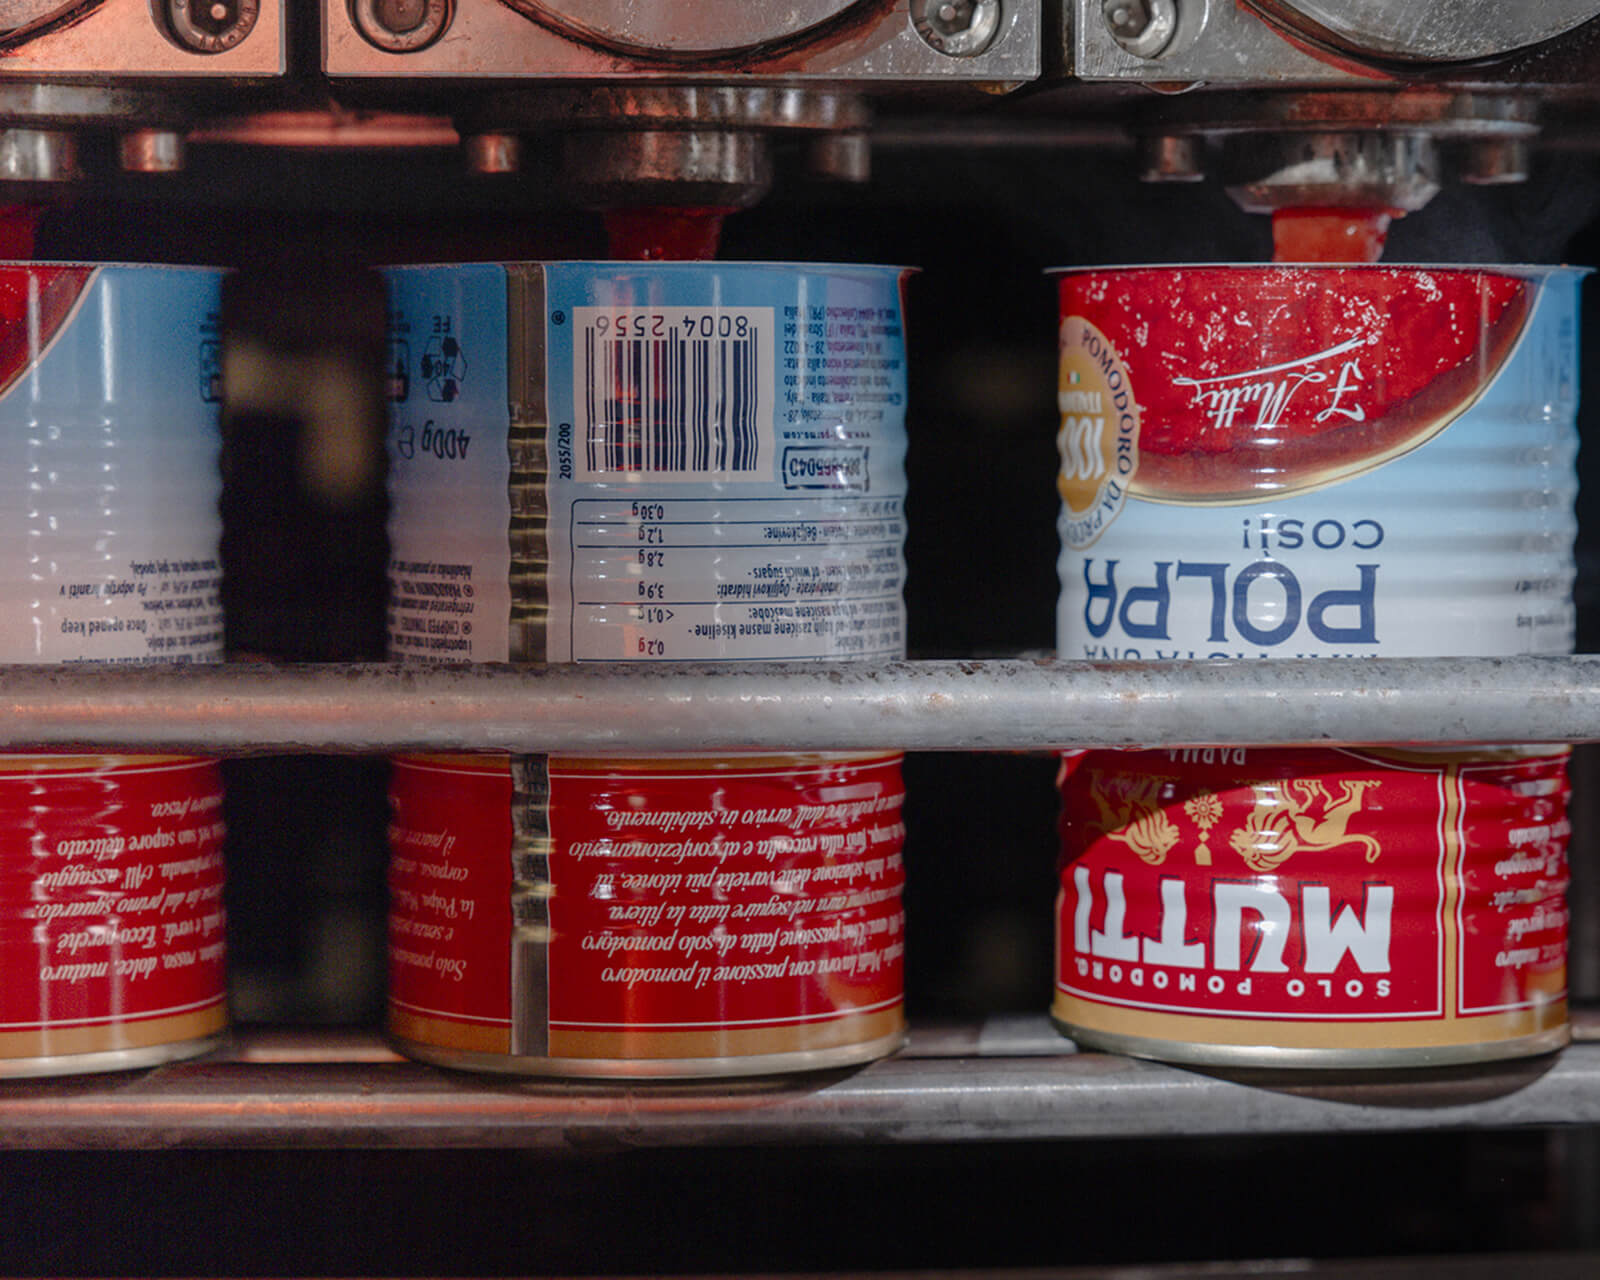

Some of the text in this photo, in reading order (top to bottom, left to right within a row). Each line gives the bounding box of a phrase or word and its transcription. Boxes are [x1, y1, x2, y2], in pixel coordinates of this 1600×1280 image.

[433, 316, 451, 333] FE
[595, 314, 748, 337] 8004 2556
[1081, 327, 1134, 475] POMODORO
[1187, 372, 1326, 431] Mutti
[421, 420, 470, 460] 400g
[558, 423, 571, 479] 2055/200
[1101, 480, 1121, 513] DA
[632, 502, 664, 520] 0,30 g
[638, 525, 664, 543] 1,2 g
[1242, 518, 1385, 557] COSÌ!
[638, 549, 664, 567] 2,8 g
[753, 564, 783, 579] sugars
[638, 581, 664, 598] 3,9 g
[648, 606, 664, 623] 0,1
[1083, 558, 1381, 647] POLPA
[61, 619, 86, 637] keep
[126, 620, 146, 634] Once
[695, 624, 736, 640] kiseline
[739, 624, 772, 638] masne
[638, 637, 664, 655] 0,2 g
[603, 809, 717, 834] stabilimento.
[719, 809, 739, 830] in
[741, 807, 792, 829] arrivo
[56, 835, 125, 861] delicato
[128, 827, 175, 852] sapore
[442, 836, 456, 857] il
[567, 837, 719, 865] confezionamento
[742, 840, 754, 856] e
[756, 837, 818, 863] raccolta
[719, 840, 740, 864] al
[40, 864, 119, 891] assaggio
[620, 872, 683, 896] idonee,
[685, 866, 718, 894] più
[717, 870, 776, 892] varietà
[116, 887, 166, 915] primo
[421, 889, 458, 919] Polpa
[460, 899, 475, 920] la
[731, 895, 792, 922] seguire
[790, 898, 816, 922] nel
[608, 901, 668, 927] filiera
[666, 905, 687, 927] la
[689, 904, 731, 924] tutta
[1073, 864, 1395, 974] MUTTI
[55, 921, 120, 956] perché
[120, 926, 157, 949] Ecco
[582, 929, 680, 958] pomodoro
[678, 934, 715, 958] solo
[718, 933, 737, 958] di
[741, 928, 780, 955] fatta
[780, 919, 841, 950] passione
[40, 962, 109, 984] maturo
[436, 958, 467, 982] Solo
[601, 960, 698, 990] pomodoro
[695, 967, 712, 990] il
[713, 956, 789, 984] passione
[789, 960, 815, 977] con
[1074, 956, 1251, 996] POMODORO.
[1286, 979, 1391, 998] SOLO
